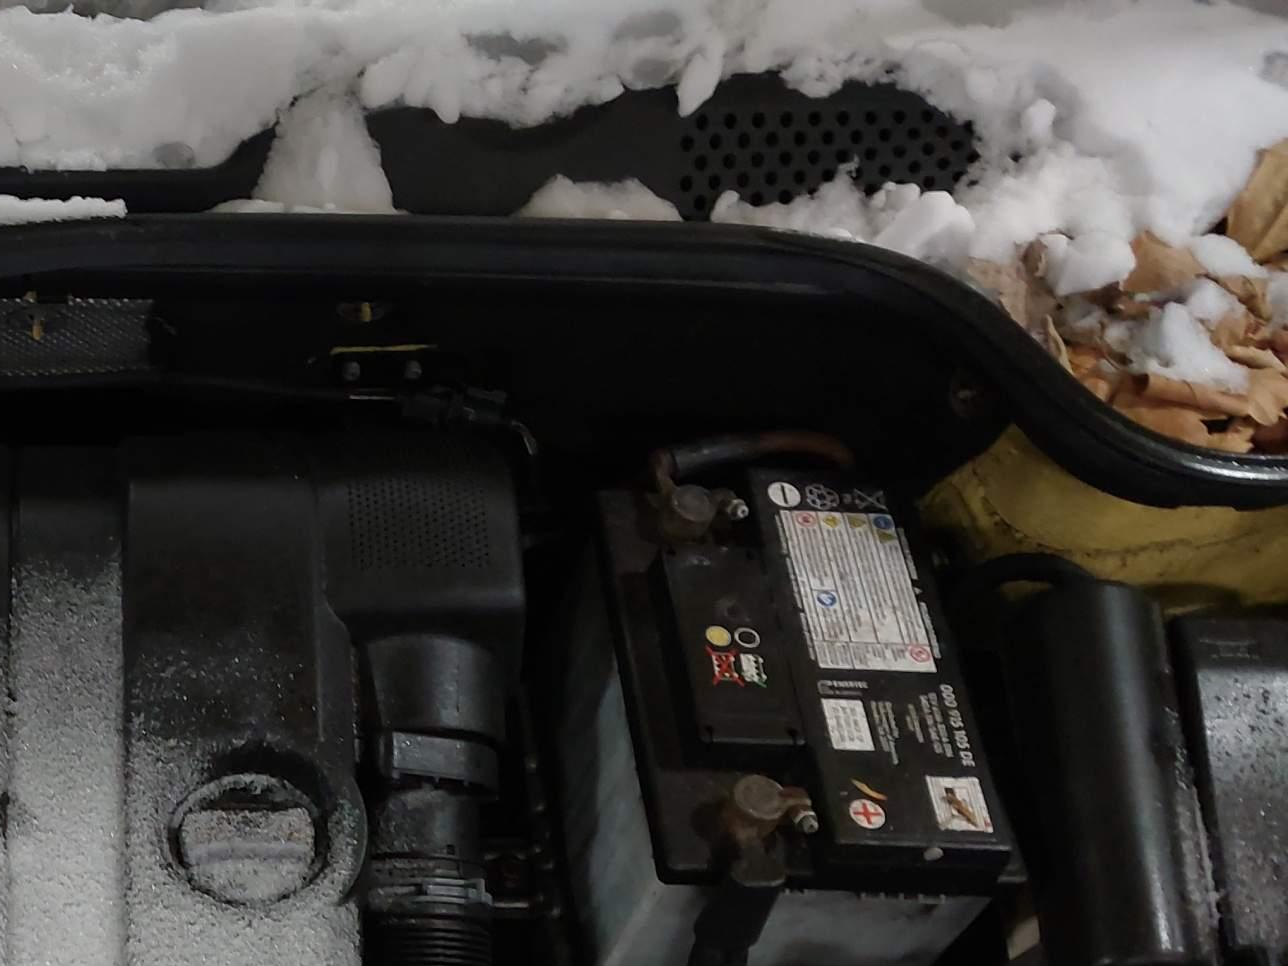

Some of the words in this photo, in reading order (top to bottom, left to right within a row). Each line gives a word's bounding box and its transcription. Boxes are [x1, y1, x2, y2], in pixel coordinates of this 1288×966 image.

[939, 684, 958, 708] 000
[953, 730, 970, 749] 105
[959, 751, 976, 767] DE
